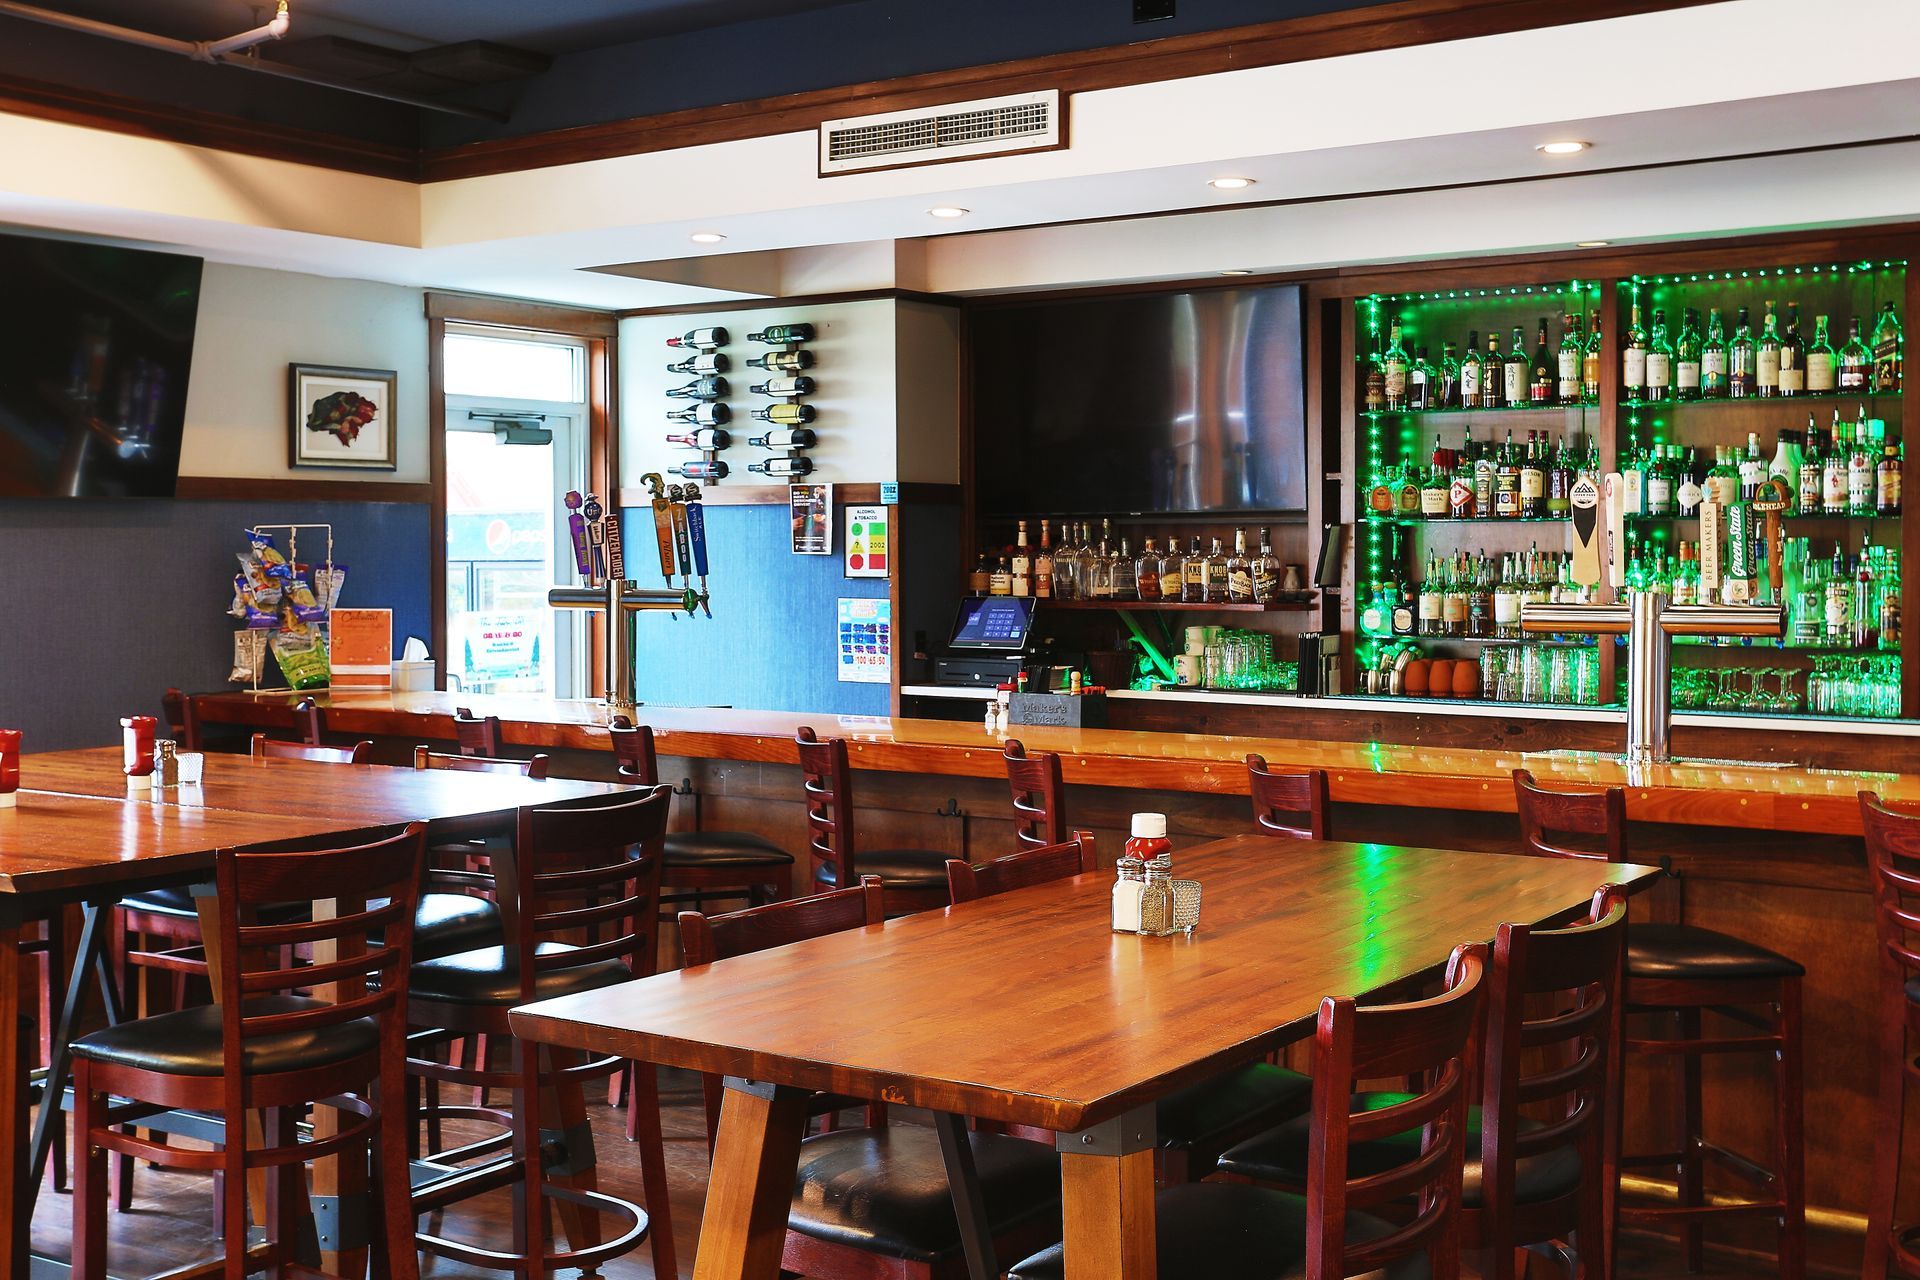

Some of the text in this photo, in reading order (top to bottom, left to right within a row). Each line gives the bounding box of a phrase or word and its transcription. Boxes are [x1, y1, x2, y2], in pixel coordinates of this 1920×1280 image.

[607, 520, 624, 579] CITIZEN CIDER
[1730, 505, 1747, 578] Green State
[1023, 703, 1068, 714] Maker's
